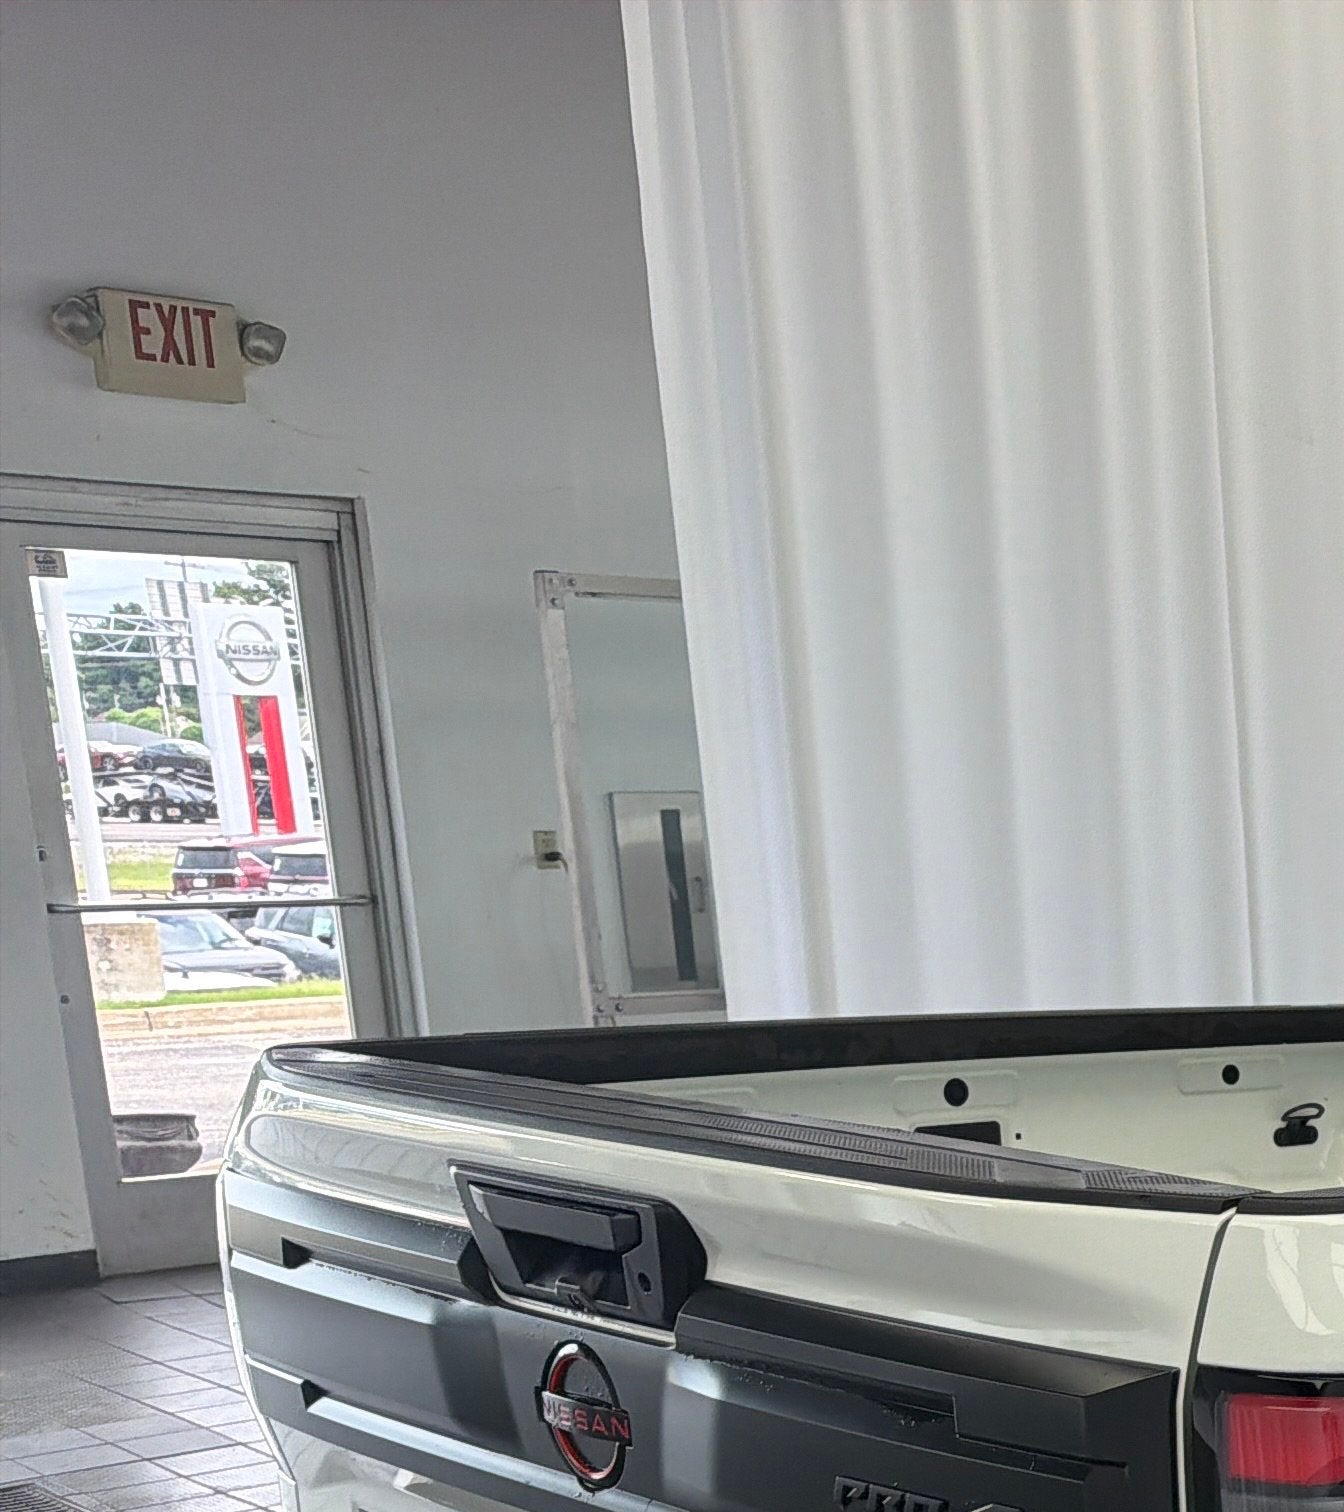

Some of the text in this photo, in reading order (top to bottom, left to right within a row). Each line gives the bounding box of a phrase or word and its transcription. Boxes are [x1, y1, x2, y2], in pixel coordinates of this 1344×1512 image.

[128, 299, 216, 368] EXIT
[225, 643, 278, 656] NISSAN
[543, 1398, 630, 1440] NISSAN
